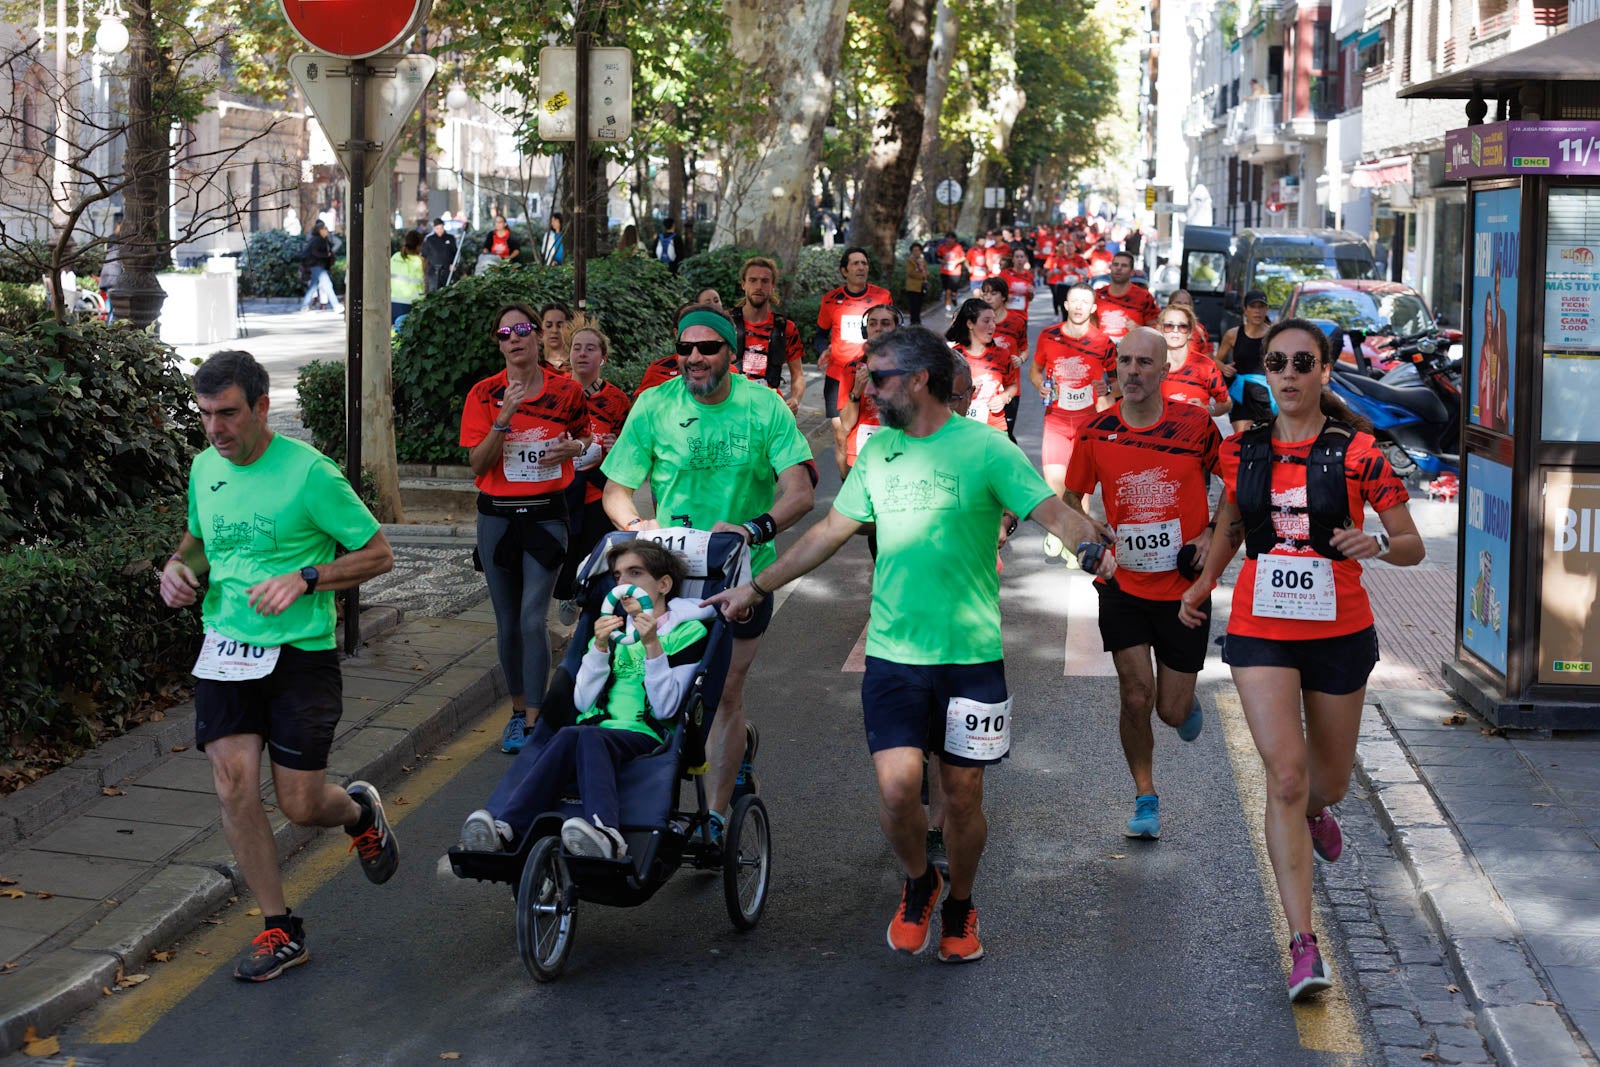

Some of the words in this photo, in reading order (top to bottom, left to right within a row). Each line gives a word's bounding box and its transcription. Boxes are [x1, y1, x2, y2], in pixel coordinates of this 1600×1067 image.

[1545, 280, 1572, 291] MÁS
[1574, 282, 1600, 291] TUY
[1561, 317, 1588, 325] GANA
[1067, 392, 1086, 400] 360
[1118, 484, 1175, 496] carrera
[1468, 486, 1484, 531] BIEN
[1483, 493, 1510, 543] JUGADO
[1124, 532, 1171, 551] 1038
[1271, 569, 1314, 590] 806
[1564, 663, 1591, 671] ONCE
[965, 713, 1005, 733] 910
